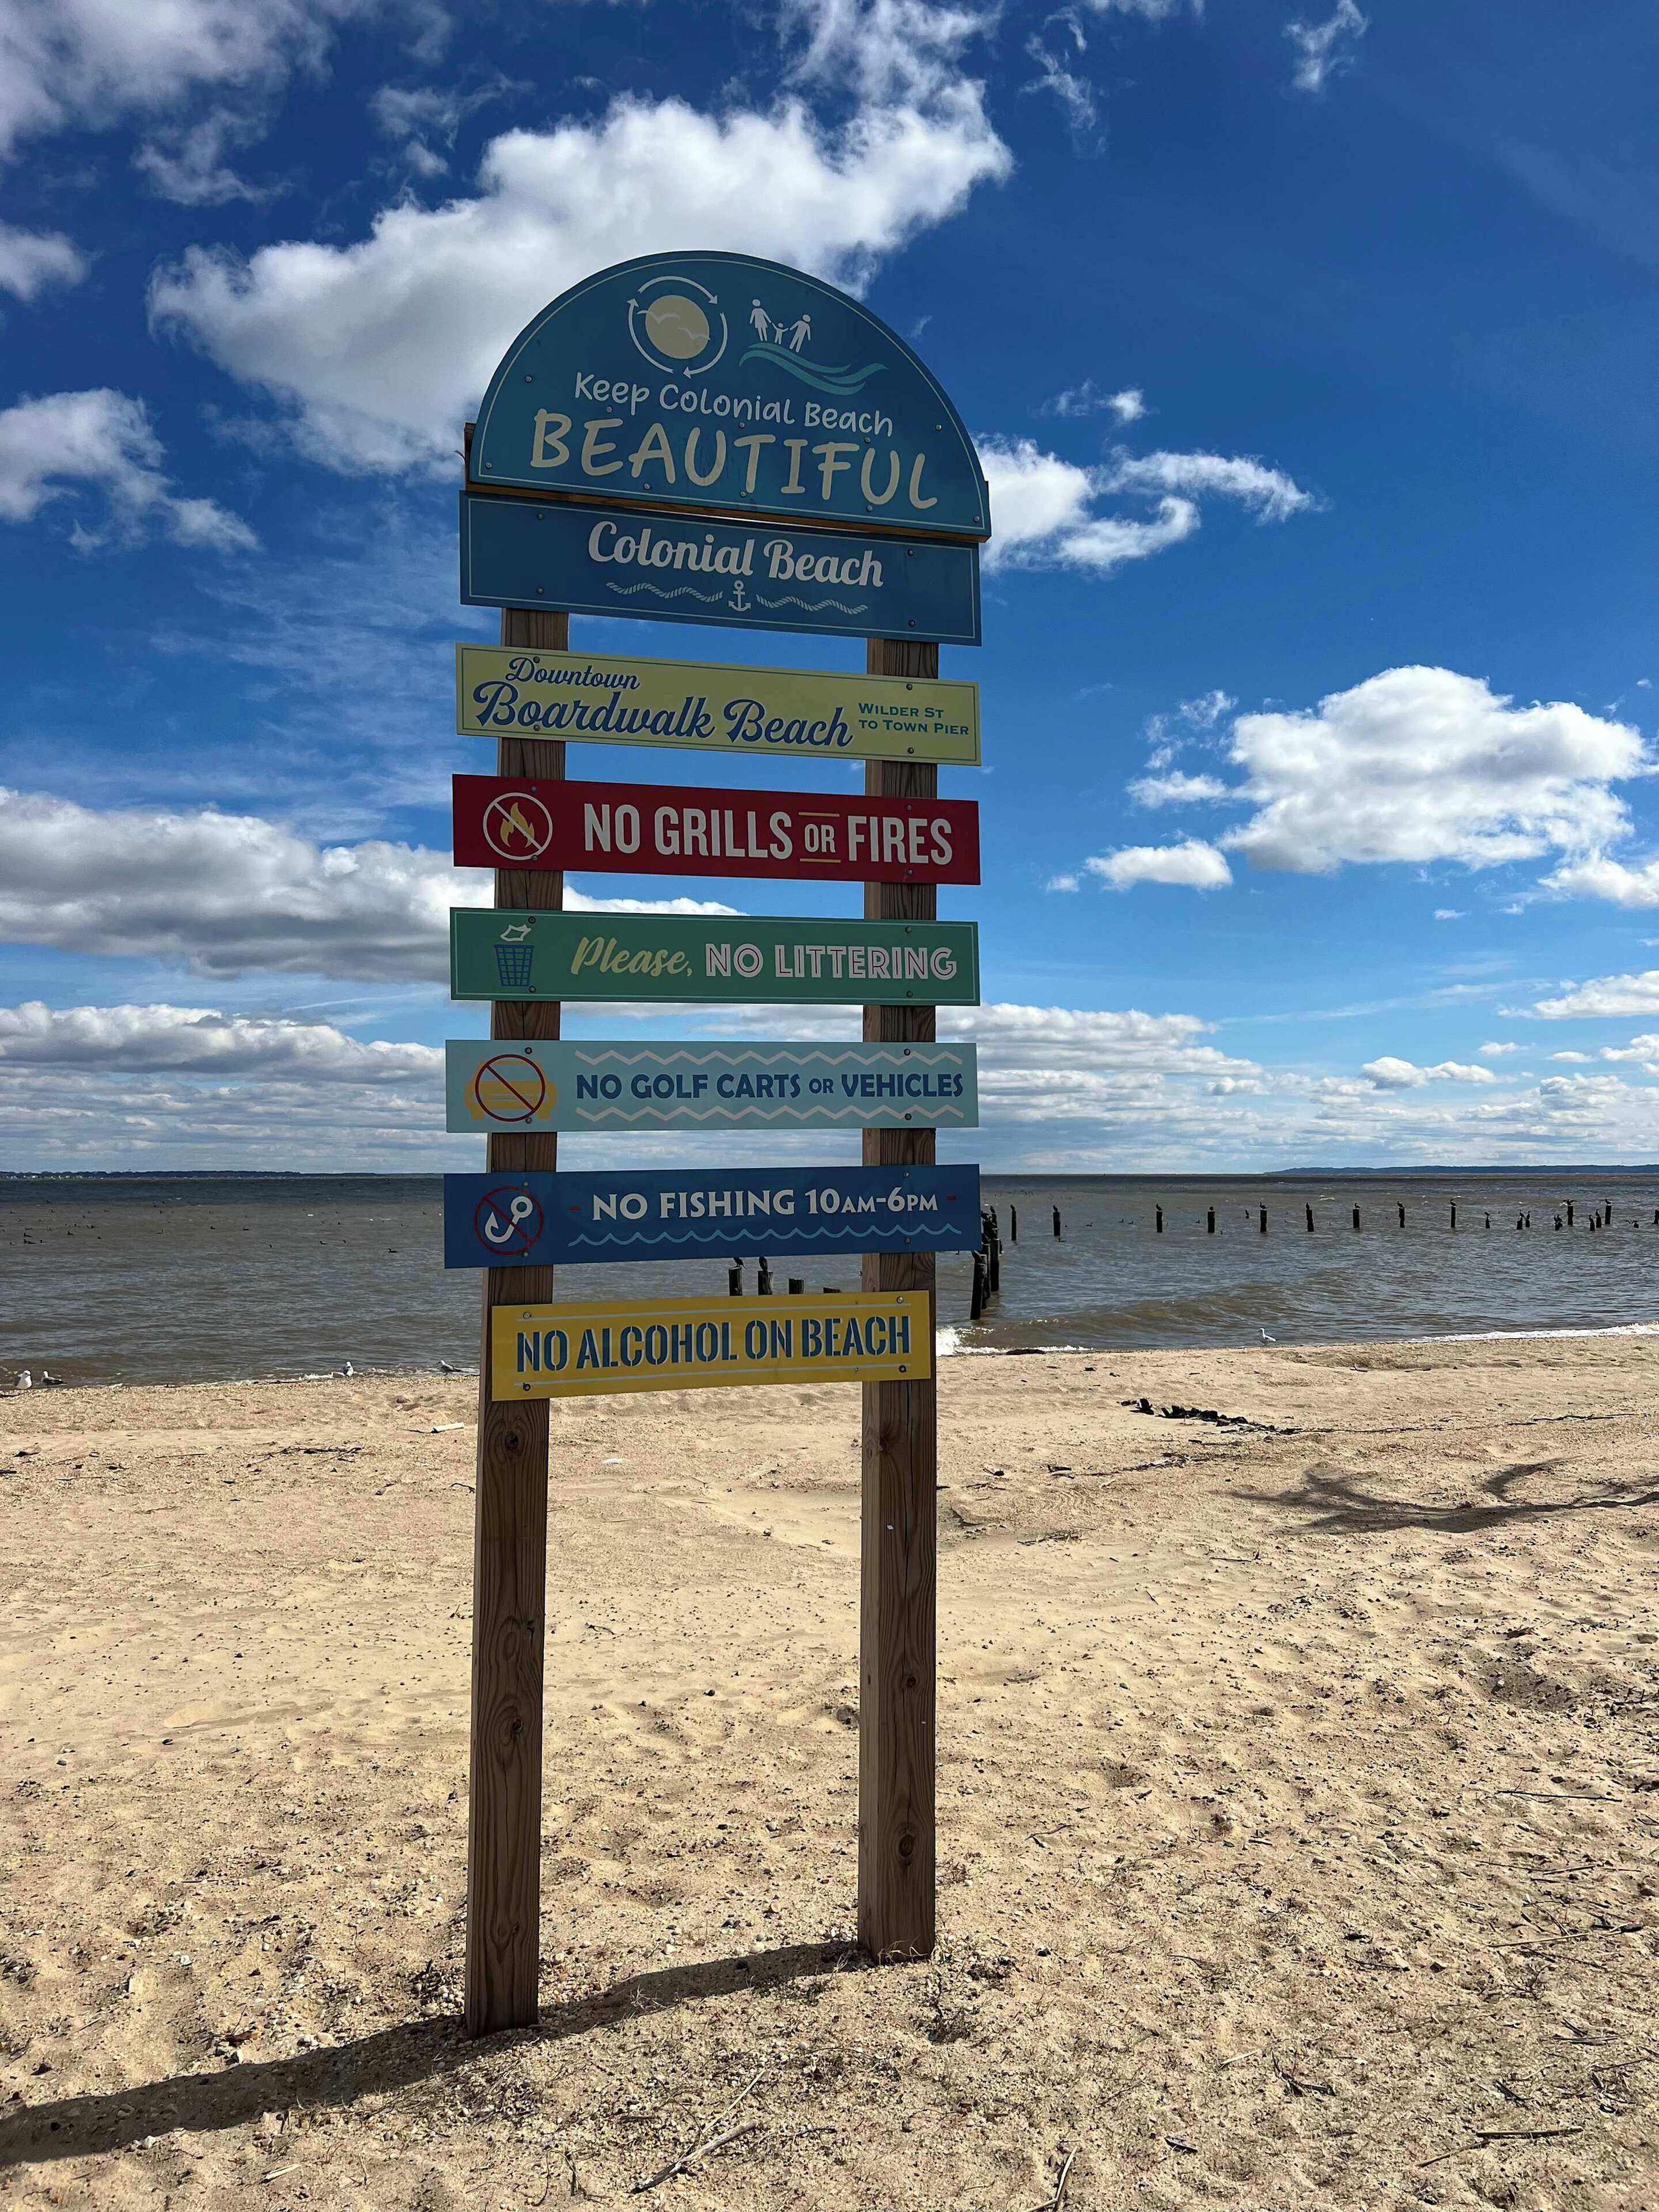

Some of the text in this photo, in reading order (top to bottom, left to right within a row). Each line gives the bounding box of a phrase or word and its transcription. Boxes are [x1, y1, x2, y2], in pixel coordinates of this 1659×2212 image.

[575, 372, 893, 437] Keep Colonial Beach
[530, 408, 938, 509] BEAUTIFUL
[588, 521, 884, 588] Colonial Beach
[505, 657, 641, 691] Downtown
[472, 681, 854, 747] Boardwalk Beach
[858, 703, 944, 719] WILDER ST
[858, 719, 969, 735] TO TOWN PIER
[584, 803, 953, 865] NO GRILLS OR FIRES
[570, 936, 957, 980] Please, NO LITTERING
[577, 1073, 964, 1099] NO GOLF CARTS OR VEHICLES
[592, 1193, 648, 1221] NO
[660, 1190, 795, 1218] FISHING
[517, 1315, 910, 1373] NO ALCOHOL ON BEACH
